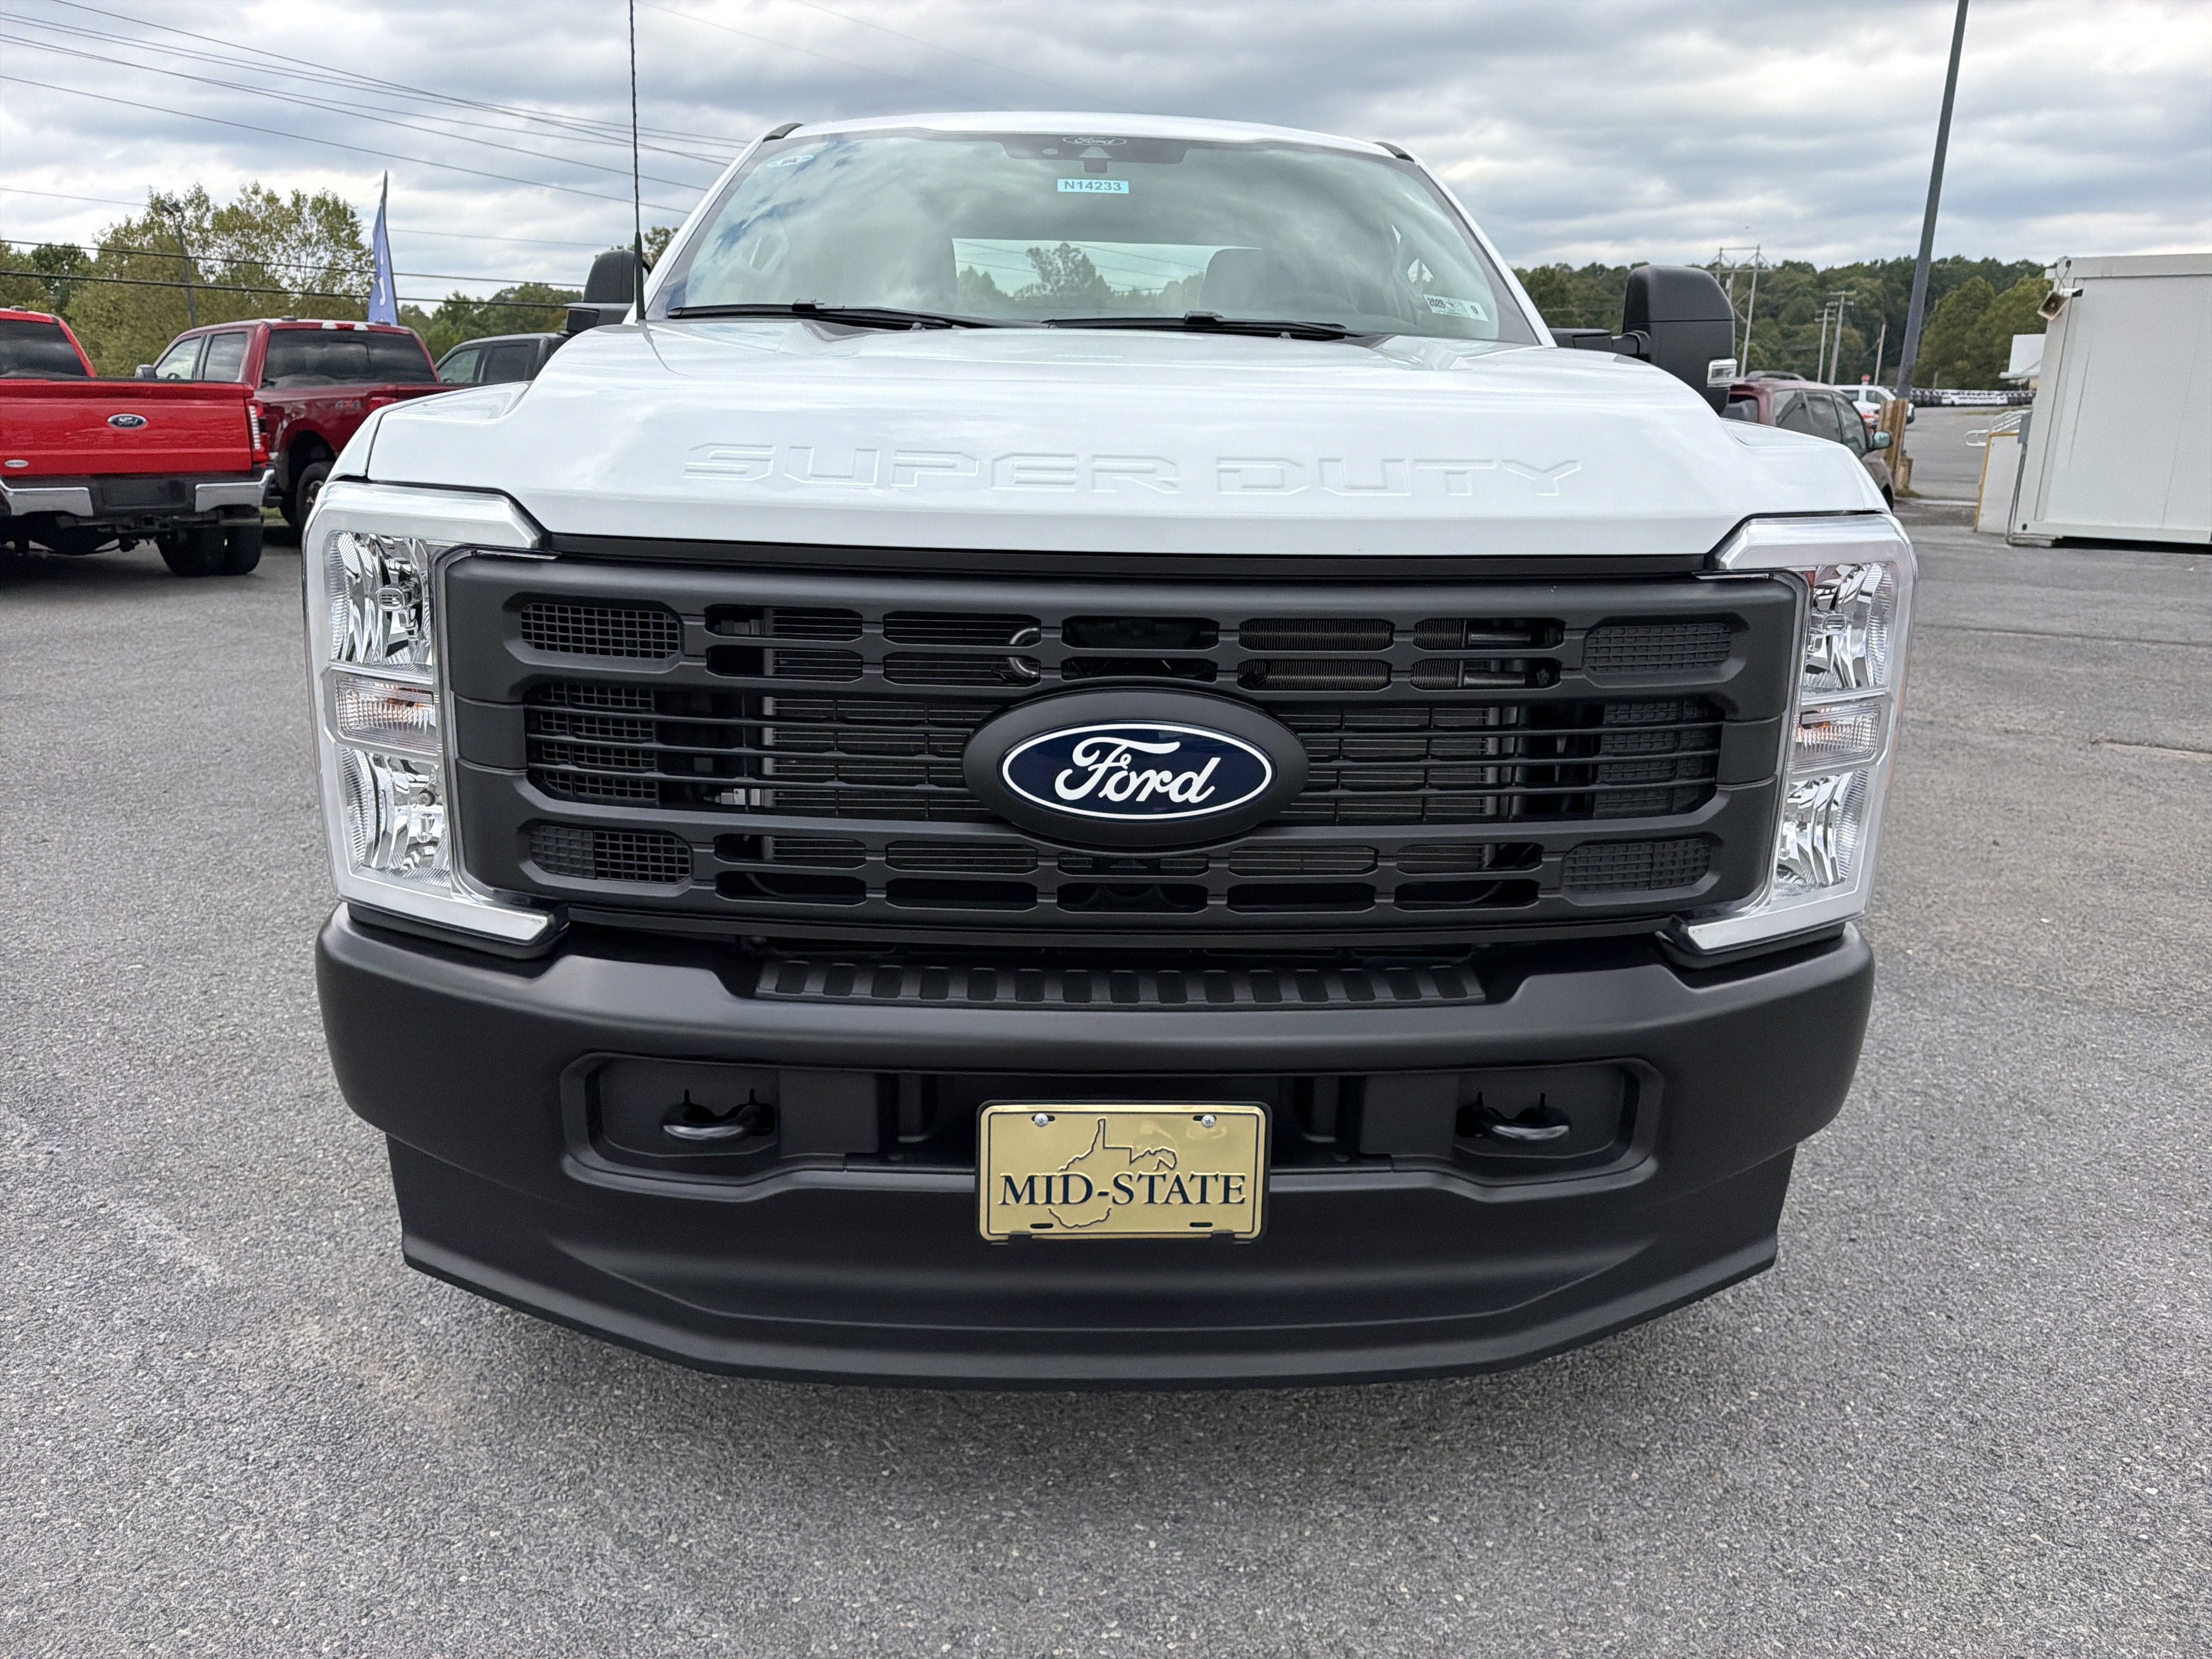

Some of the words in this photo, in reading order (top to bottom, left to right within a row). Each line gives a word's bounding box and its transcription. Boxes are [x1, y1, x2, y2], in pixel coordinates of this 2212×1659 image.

[1064, 180, 1122, 191] N14233
[684, 443, 1181, 494] SUPER
[1216, 456, 1582, 496] DUTY
[1054, 737, 1221, 803] Ford
[998, 1171, 1246, 1206] MID-STATE
